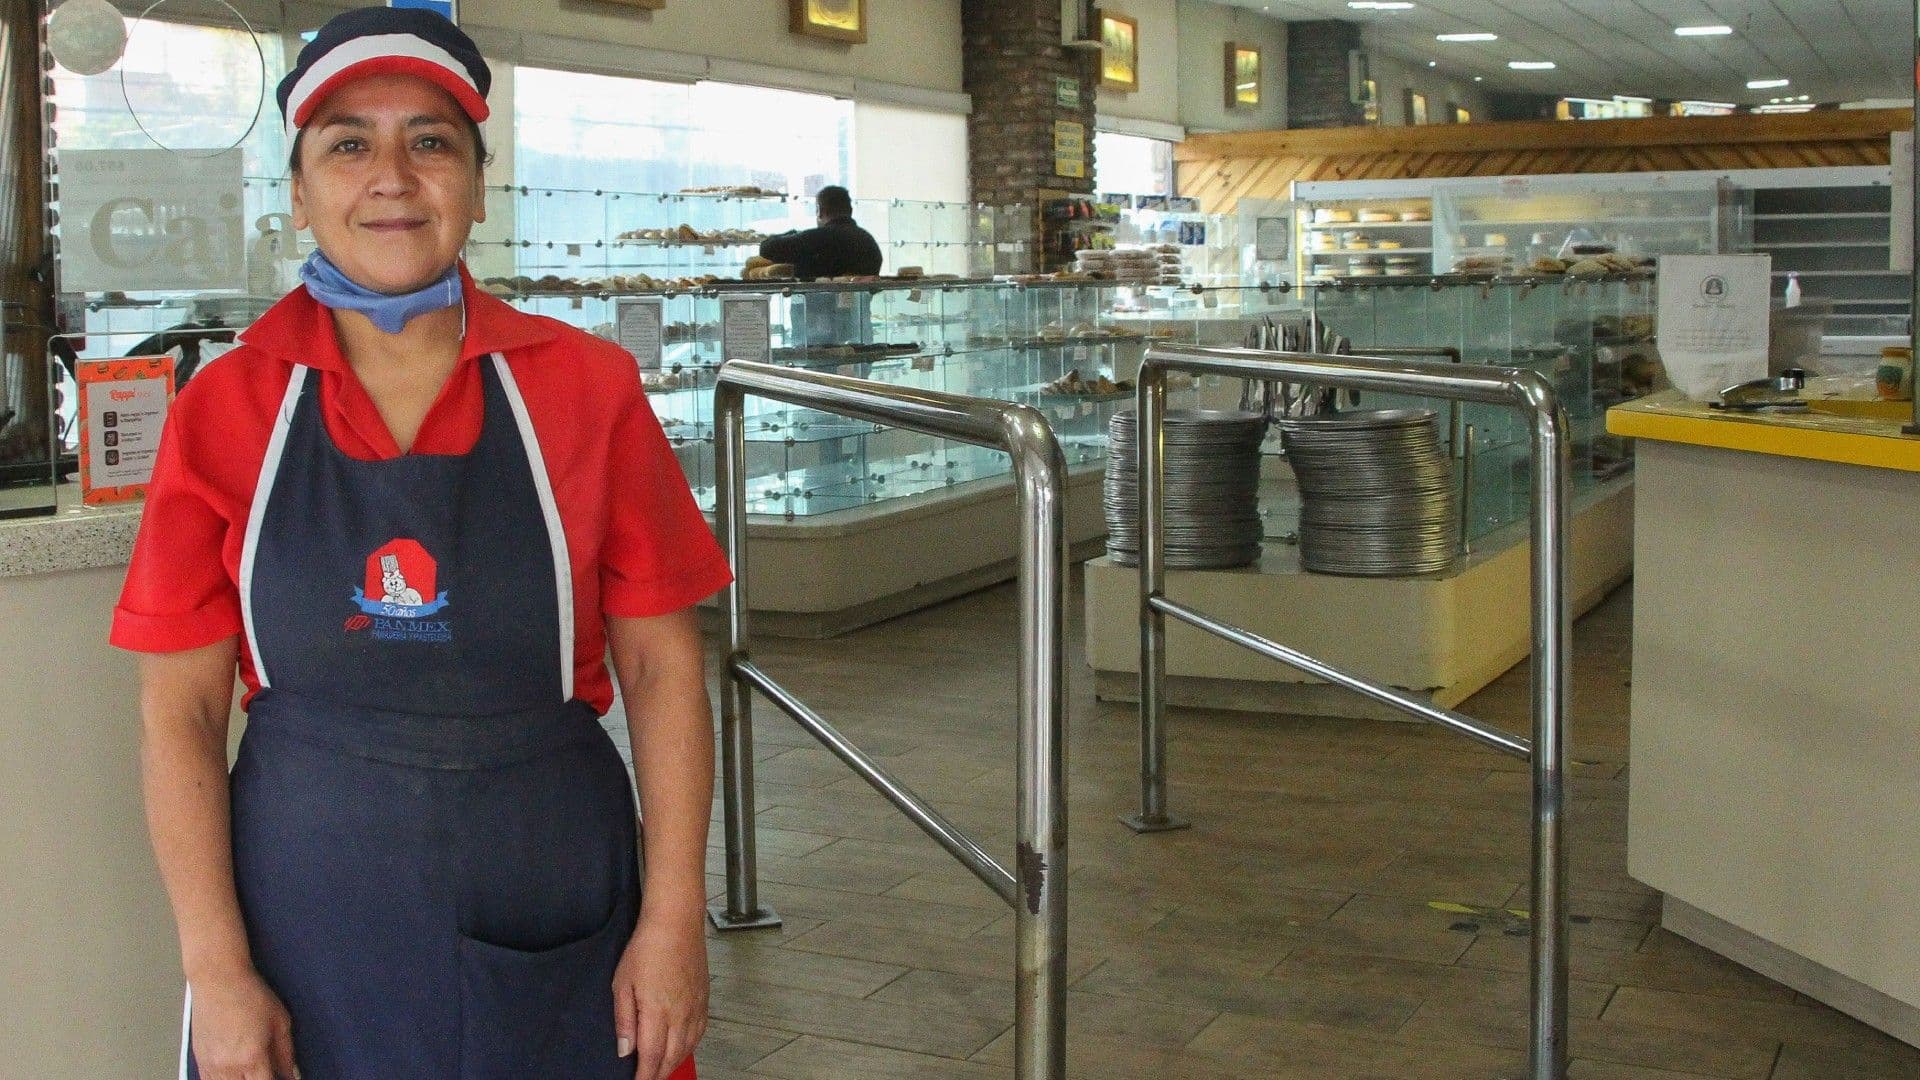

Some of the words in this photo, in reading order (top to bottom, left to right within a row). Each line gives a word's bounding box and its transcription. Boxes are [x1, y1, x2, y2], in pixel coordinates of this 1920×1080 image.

[90, 193, 304, 284] Caja
[380, 604, 395, 616] 50
[395, 606, 416, 617] años
[374, 617, 451, 632] PANMEX
